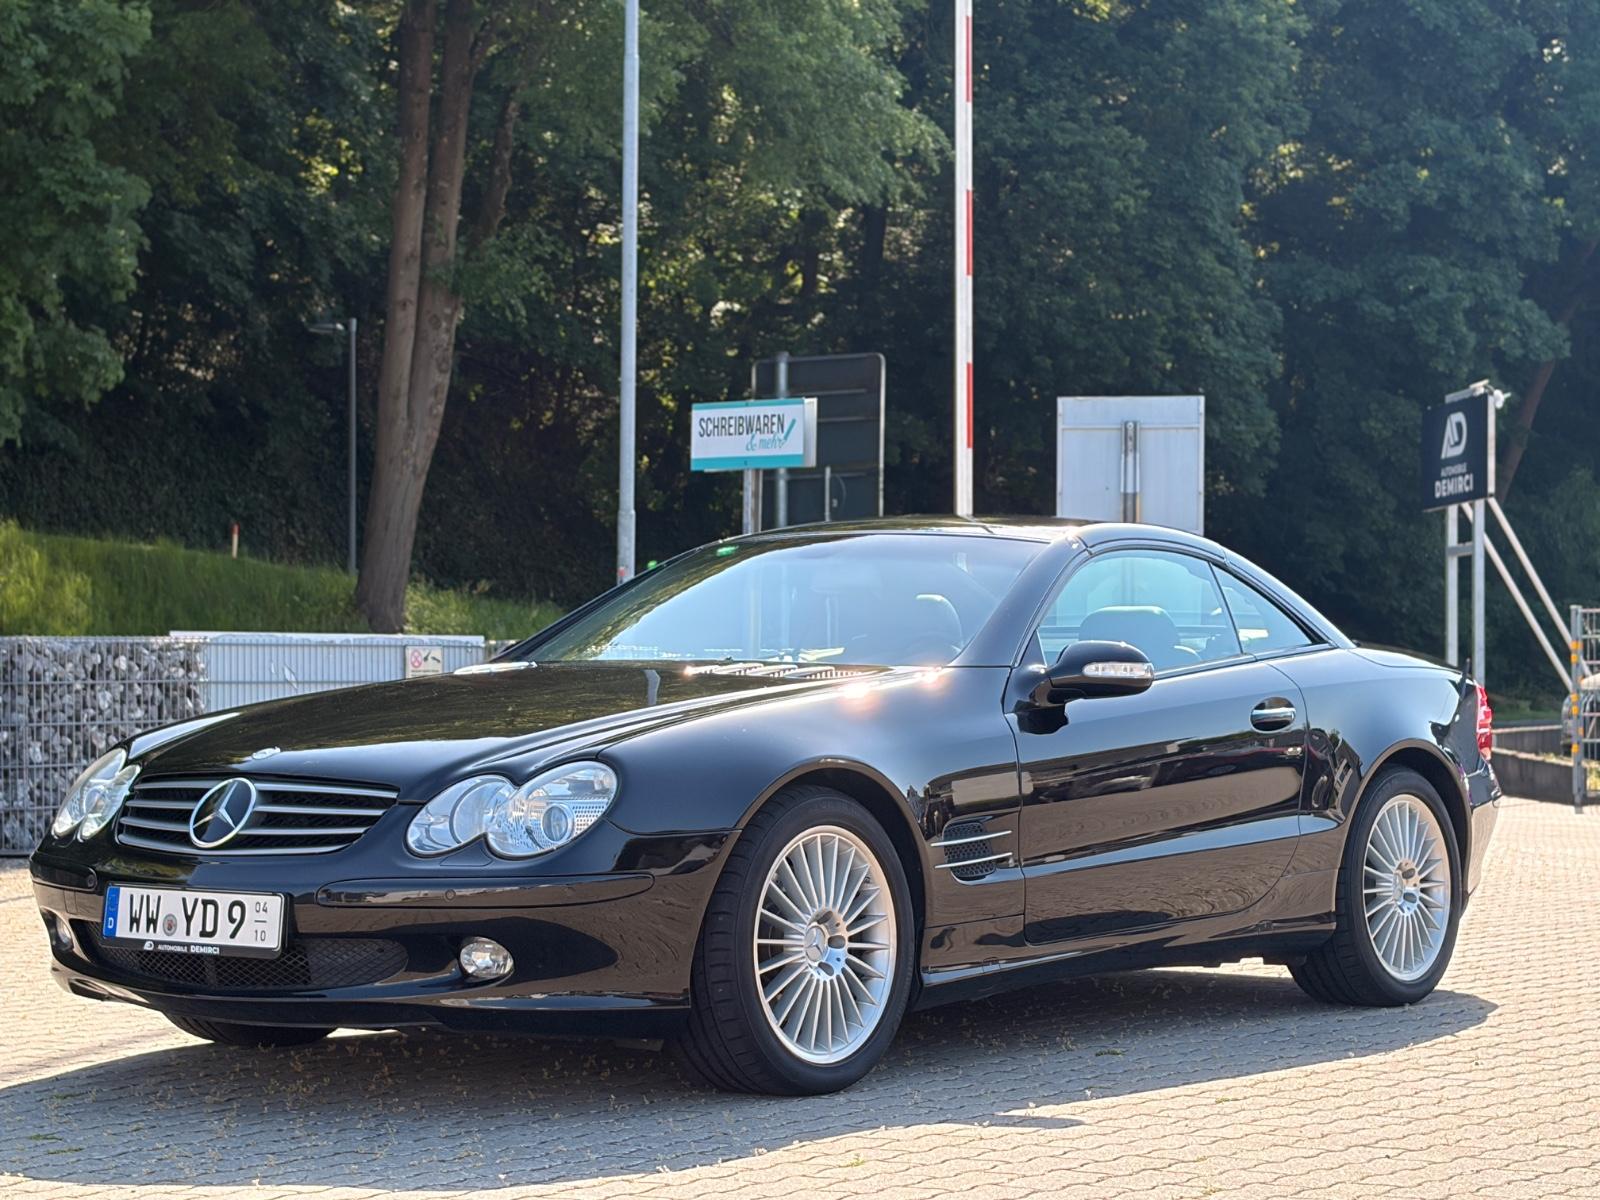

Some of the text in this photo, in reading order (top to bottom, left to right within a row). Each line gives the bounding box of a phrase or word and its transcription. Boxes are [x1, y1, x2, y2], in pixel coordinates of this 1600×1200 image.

[699, 414, 785, 438] SCHREIBWAREN
[745, 433, 757, 451] &
[1435, 473, 1474, 498] DEMIRCI
[129, 894, 162, 934] WW
[254, 901, 268, 914] 04
[107, 917, 115, 929] D
[254, 930, 266, 942] 10
[190, 945, 220, 955] DEMIRCI
